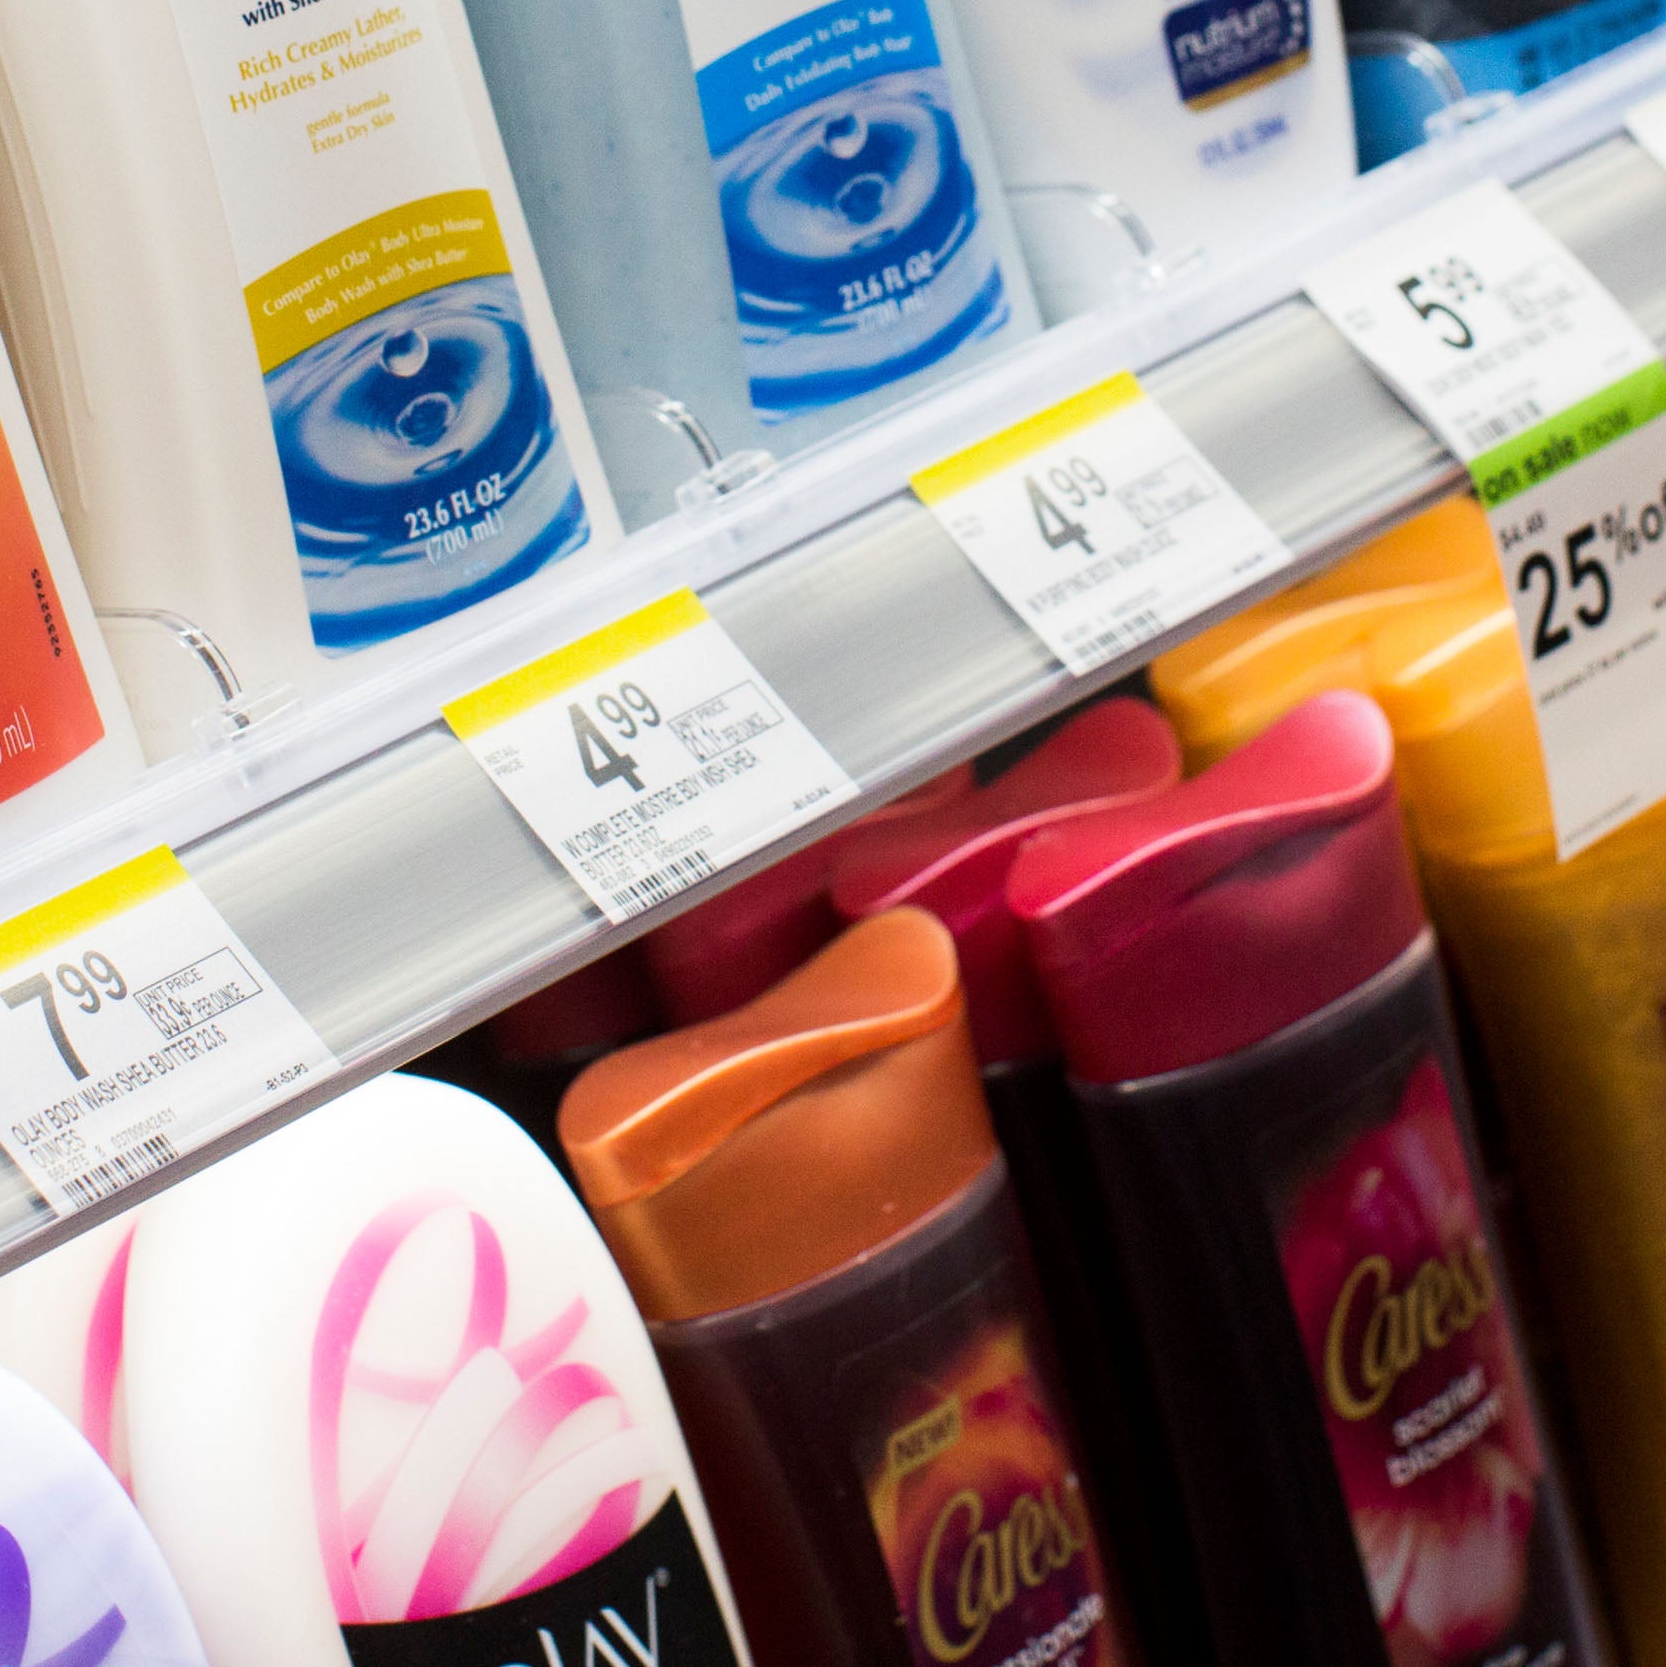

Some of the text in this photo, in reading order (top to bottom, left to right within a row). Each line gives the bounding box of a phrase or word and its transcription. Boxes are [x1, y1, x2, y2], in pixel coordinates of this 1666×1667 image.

[229, 26, 424, 115] Hydrates & Moisturizes
[1481, 404, 1633, 502] on sale now
[402, 472, 508, 539] 23.6 FL OZ
[0, 705, 37, 761] mL)
[11, 1025, 230, 1147] OLAY BODY WASH SHEA BUTTER 23.6
[29, 1130, 89, 1171] OUNCES
